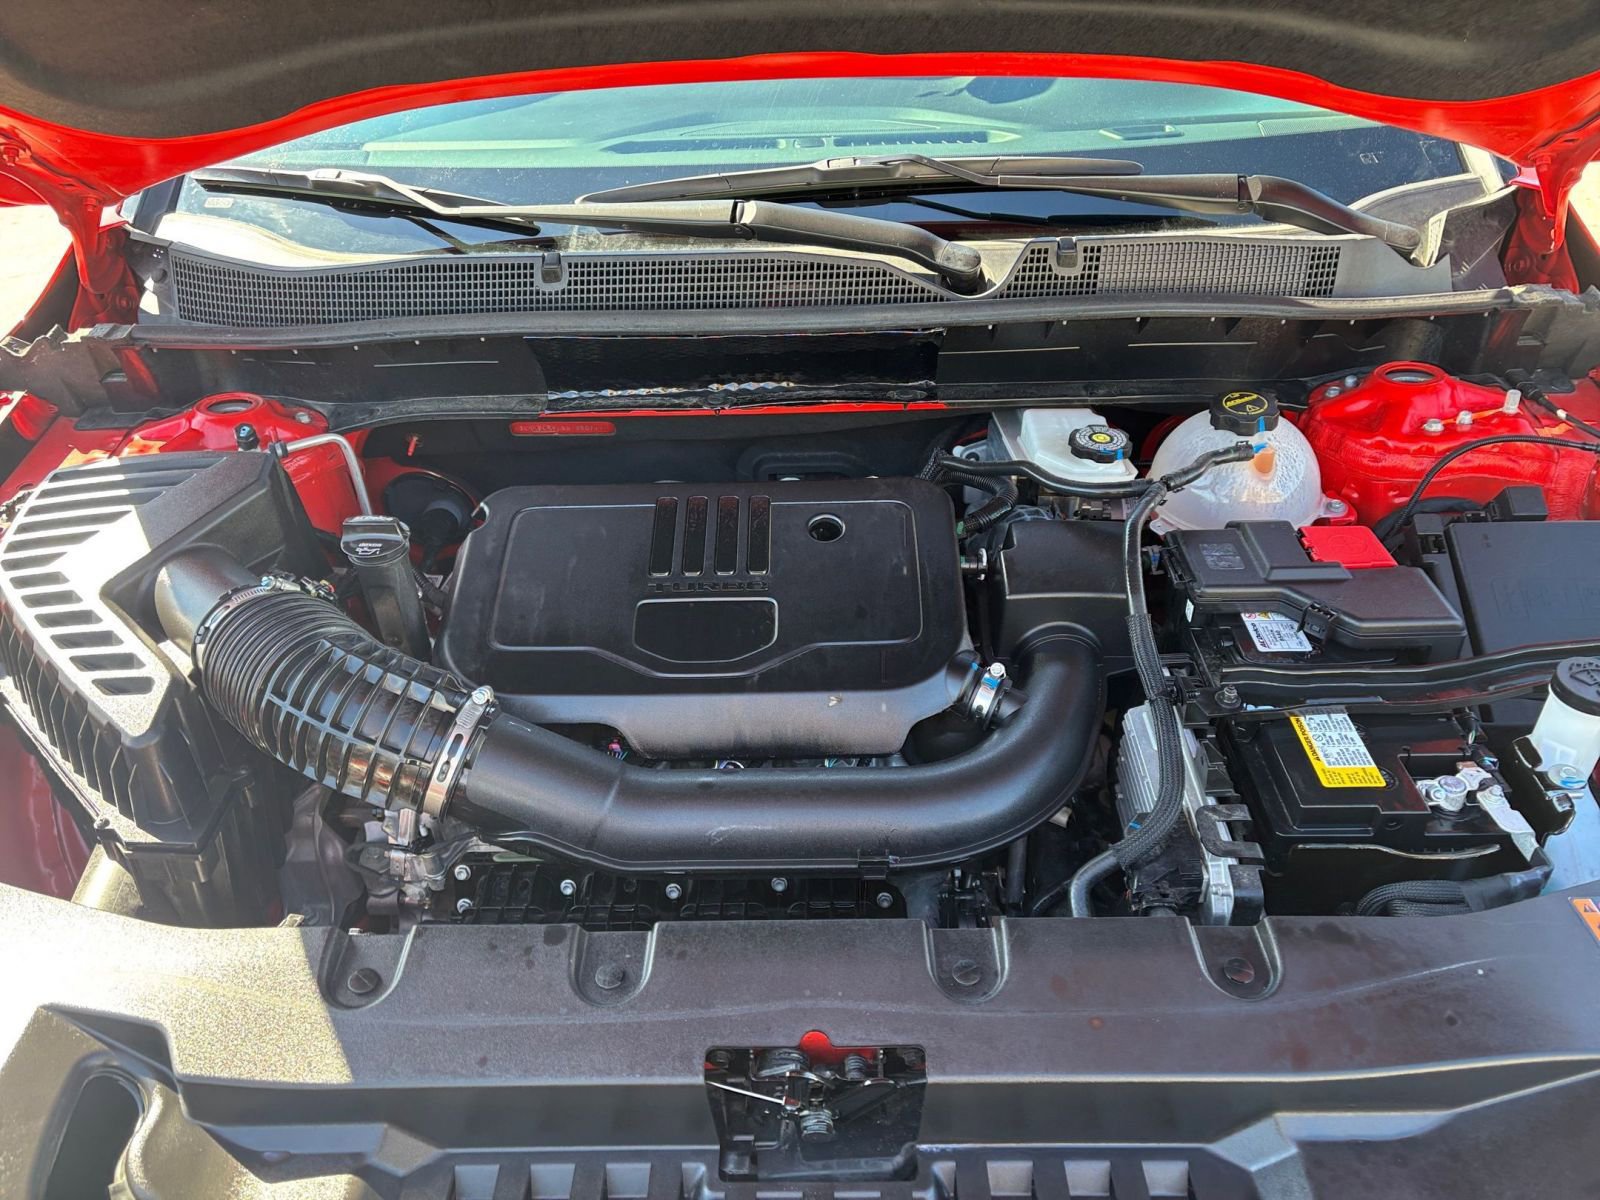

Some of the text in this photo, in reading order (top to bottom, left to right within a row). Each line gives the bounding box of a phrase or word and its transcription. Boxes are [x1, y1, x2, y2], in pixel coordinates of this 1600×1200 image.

[648, 582, 768, 592] TURBO
[1295, 718, 1318, 756] DANGER POISON
